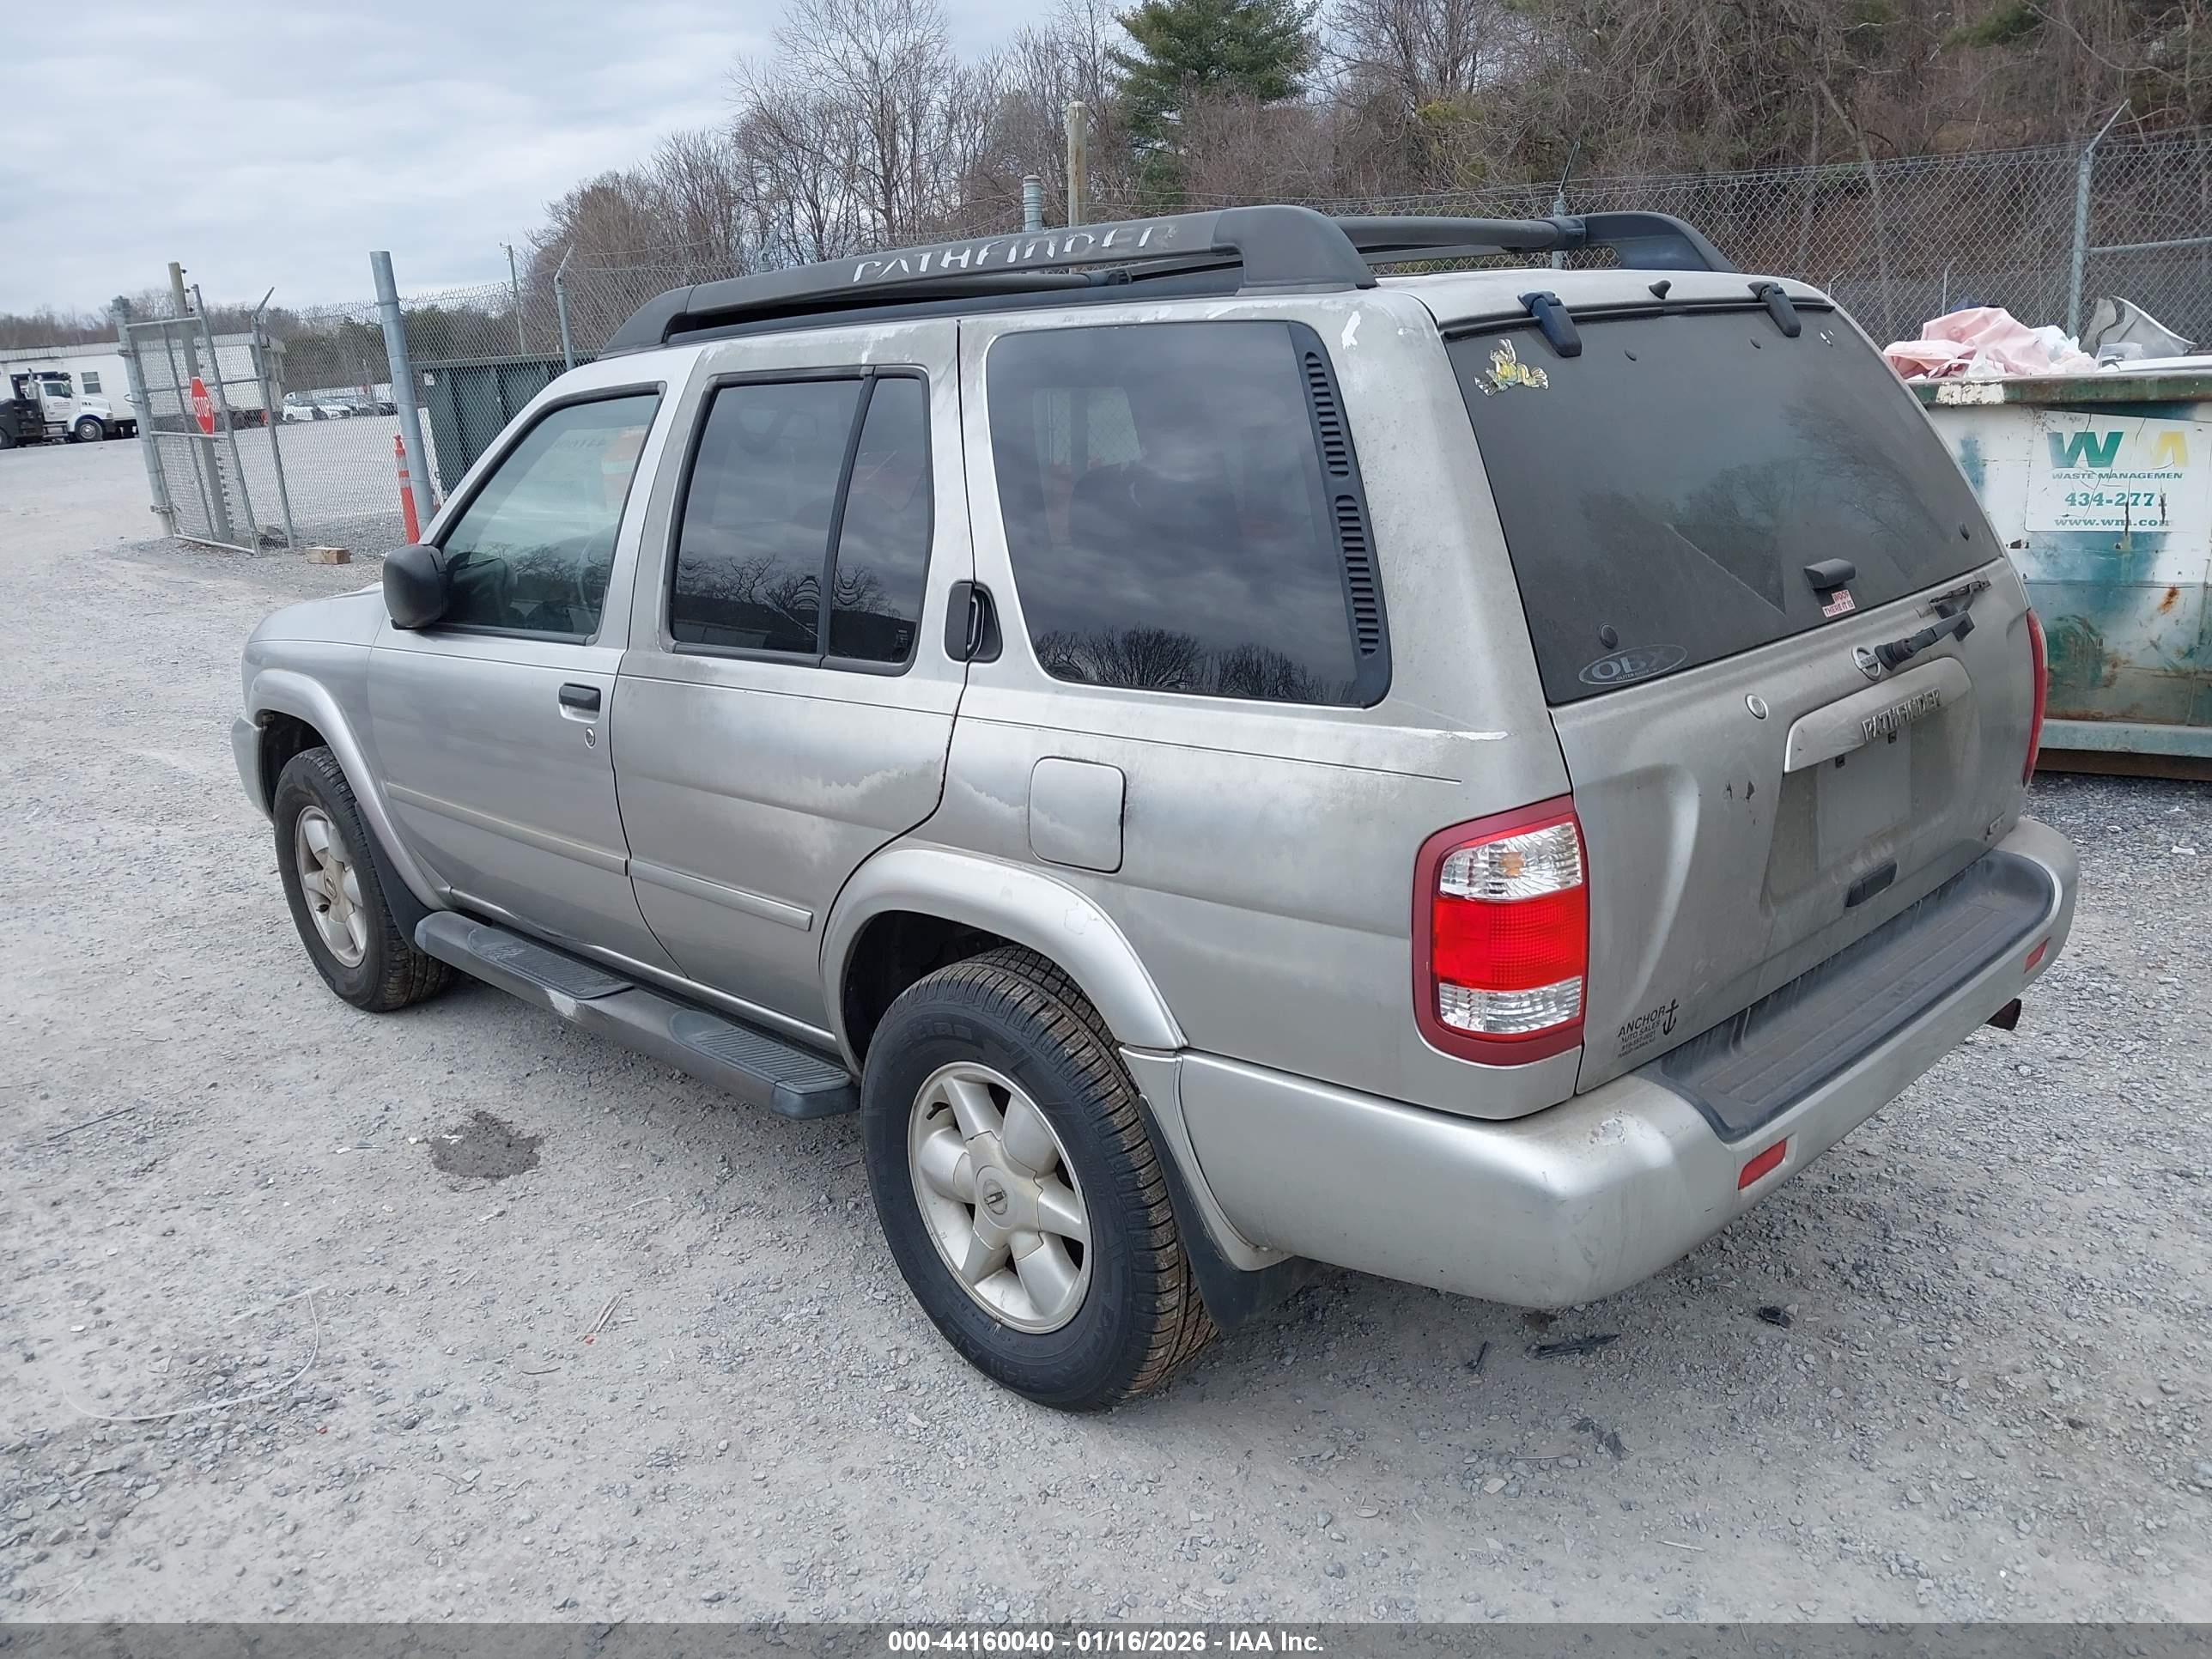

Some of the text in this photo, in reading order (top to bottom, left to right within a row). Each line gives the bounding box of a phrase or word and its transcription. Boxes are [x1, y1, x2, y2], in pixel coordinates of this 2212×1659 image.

[193, 396, 210, 417] STOP
[1862, 687, 1941, 742] PATHFINDER
[1618, 1005, 1666, 1037] ANCHOR
